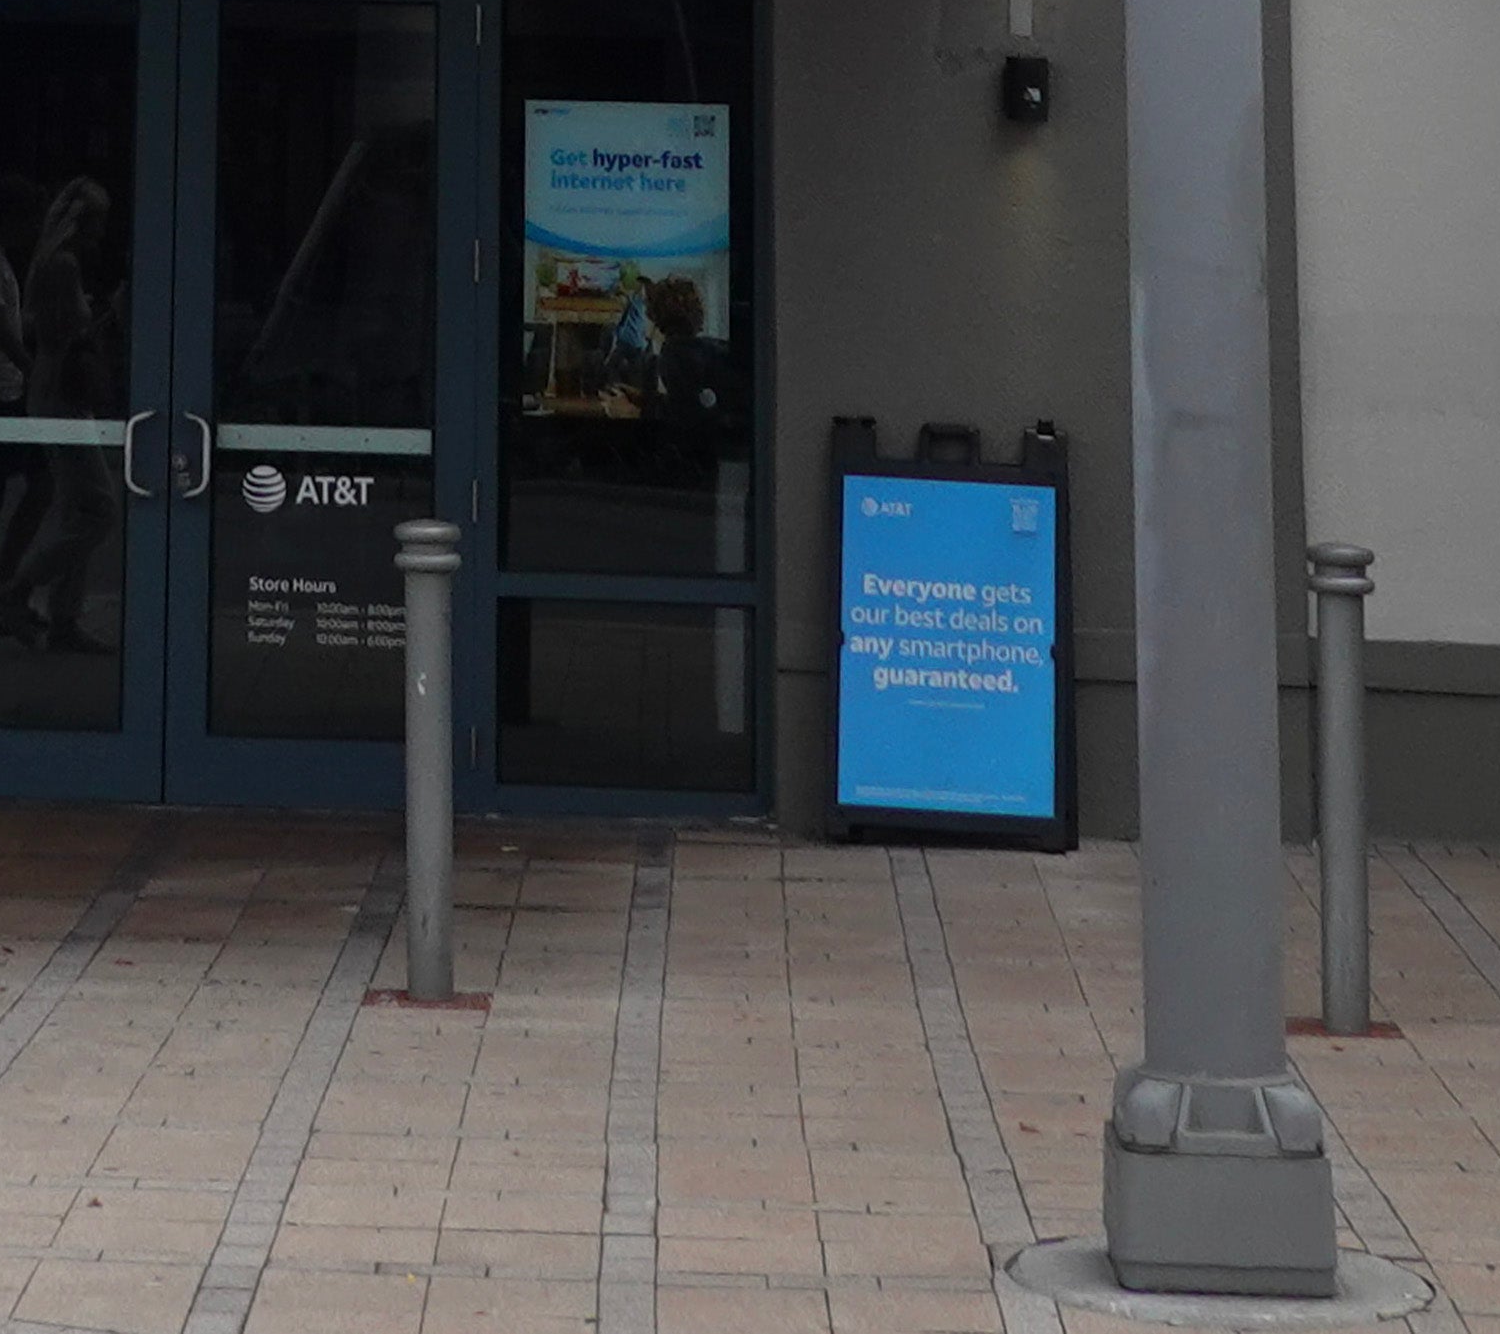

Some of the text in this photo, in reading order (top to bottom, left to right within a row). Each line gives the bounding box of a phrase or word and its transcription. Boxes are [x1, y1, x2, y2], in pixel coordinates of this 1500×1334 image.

[550, 148, 704, 173] Get hyper-fast
[639, 171, 686, 193] here
[296, 475, 374, 506] AT&T
[249, 576, 337, 594] Store Hours
[863, 573, 1031, 606] Everyone gets
[850, 604, 1043, 635] our best deals on
[850, 636, 1044, 666] any smartphone,
[873, 667, 1019, 693] guaranteed.
